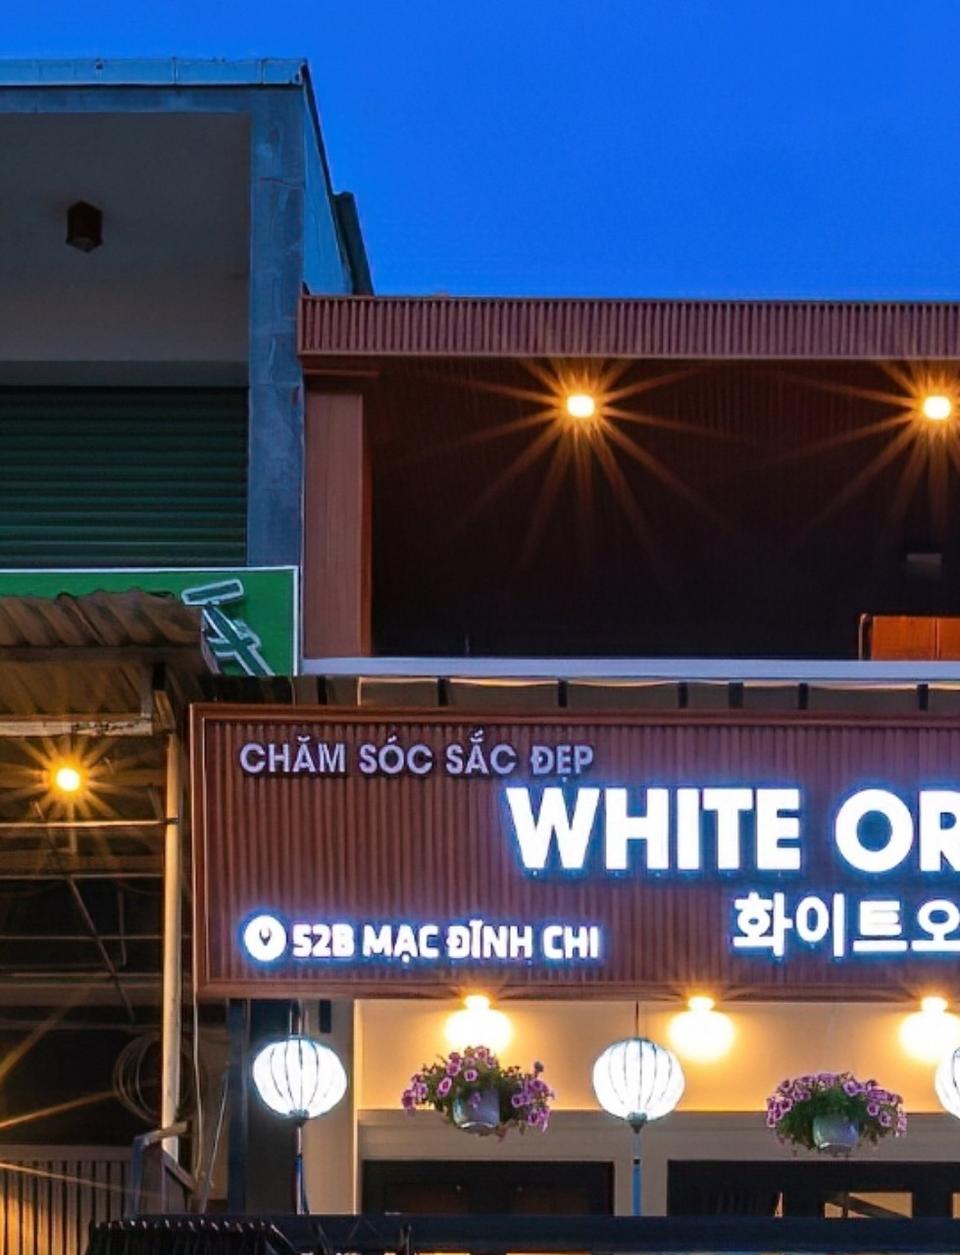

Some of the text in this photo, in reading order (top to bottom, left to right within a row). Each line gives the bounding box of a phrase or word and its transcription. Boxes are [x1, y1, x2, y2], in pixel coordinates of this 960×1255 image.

[240, 729, 594, 782] CHĂM SÓC SẮC ĐẸP
[506, 787, 801, 870] WHITE
[292, 924, 354, 958] 52B
[362, 924, 438, 963] MẠC
[543, 926, 600, 958] CHI
